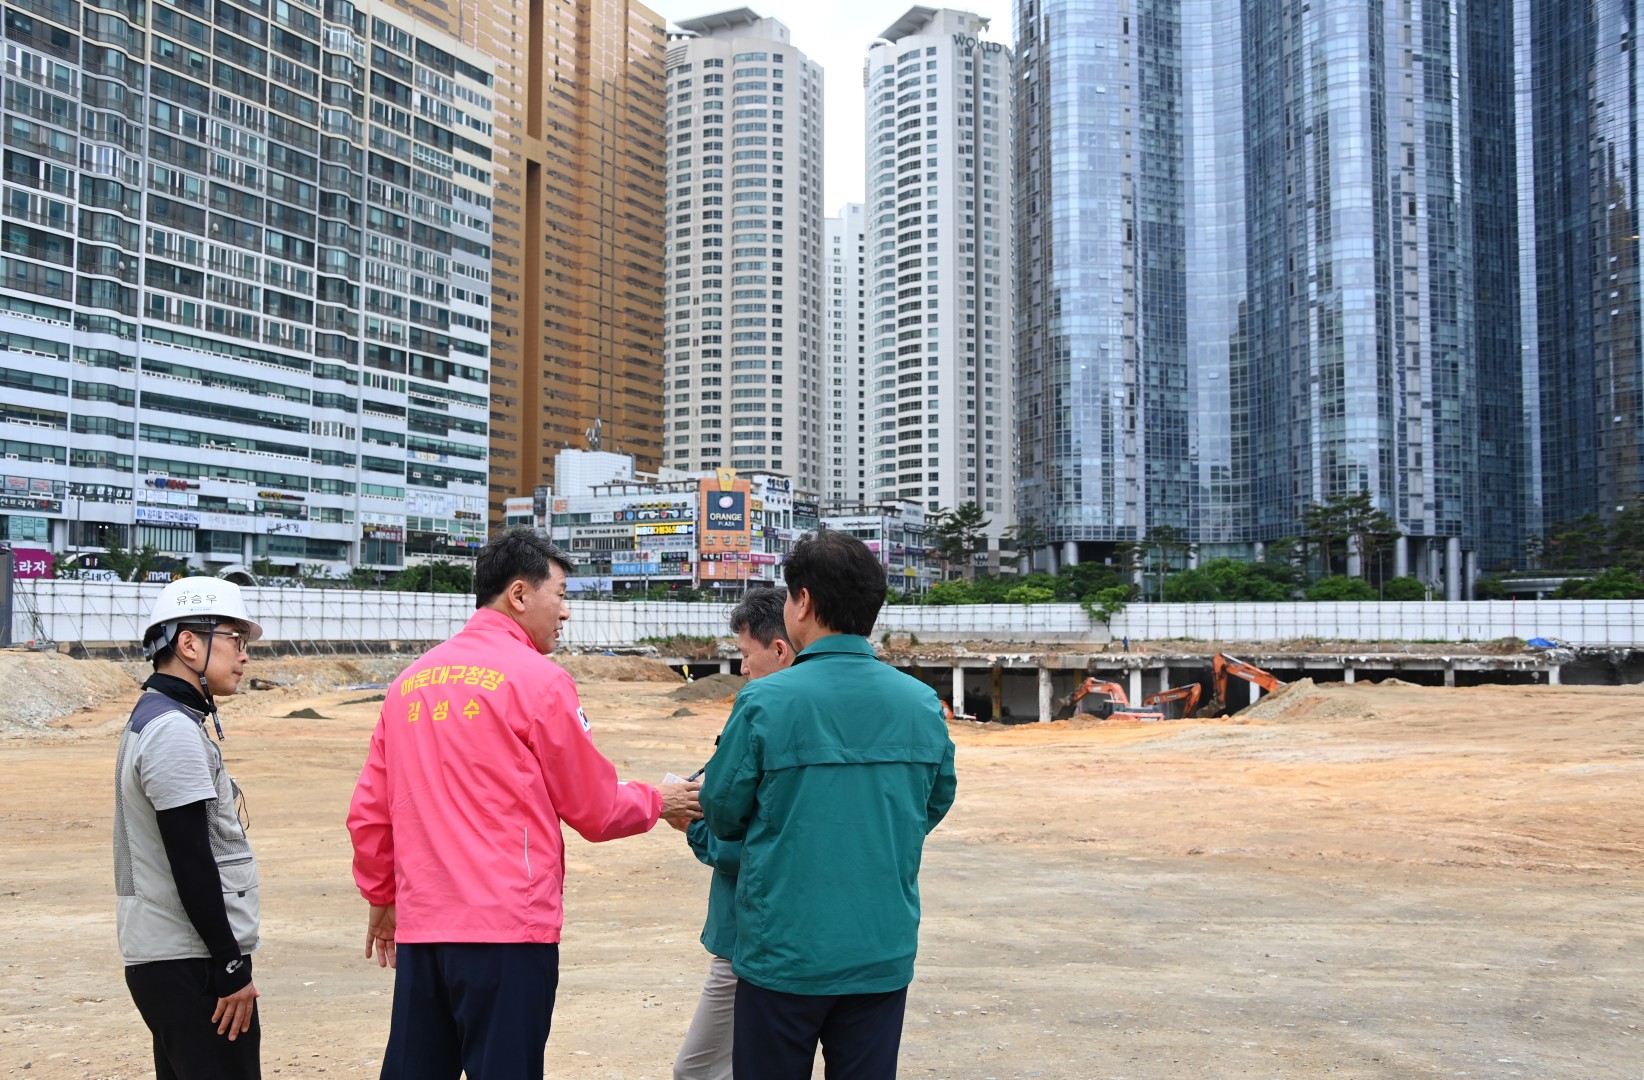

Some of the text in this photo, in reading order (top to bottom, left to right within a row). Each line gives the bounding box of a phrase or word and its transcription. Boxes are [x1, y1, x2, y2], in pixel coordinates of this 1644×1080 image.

[953, 34, 1001, 53] WORLD
[710, 513, 743, 521] ORANGE
[177, 594, 218, 606] 유승우
[400, 665, 505, 697] 해운대구청장
